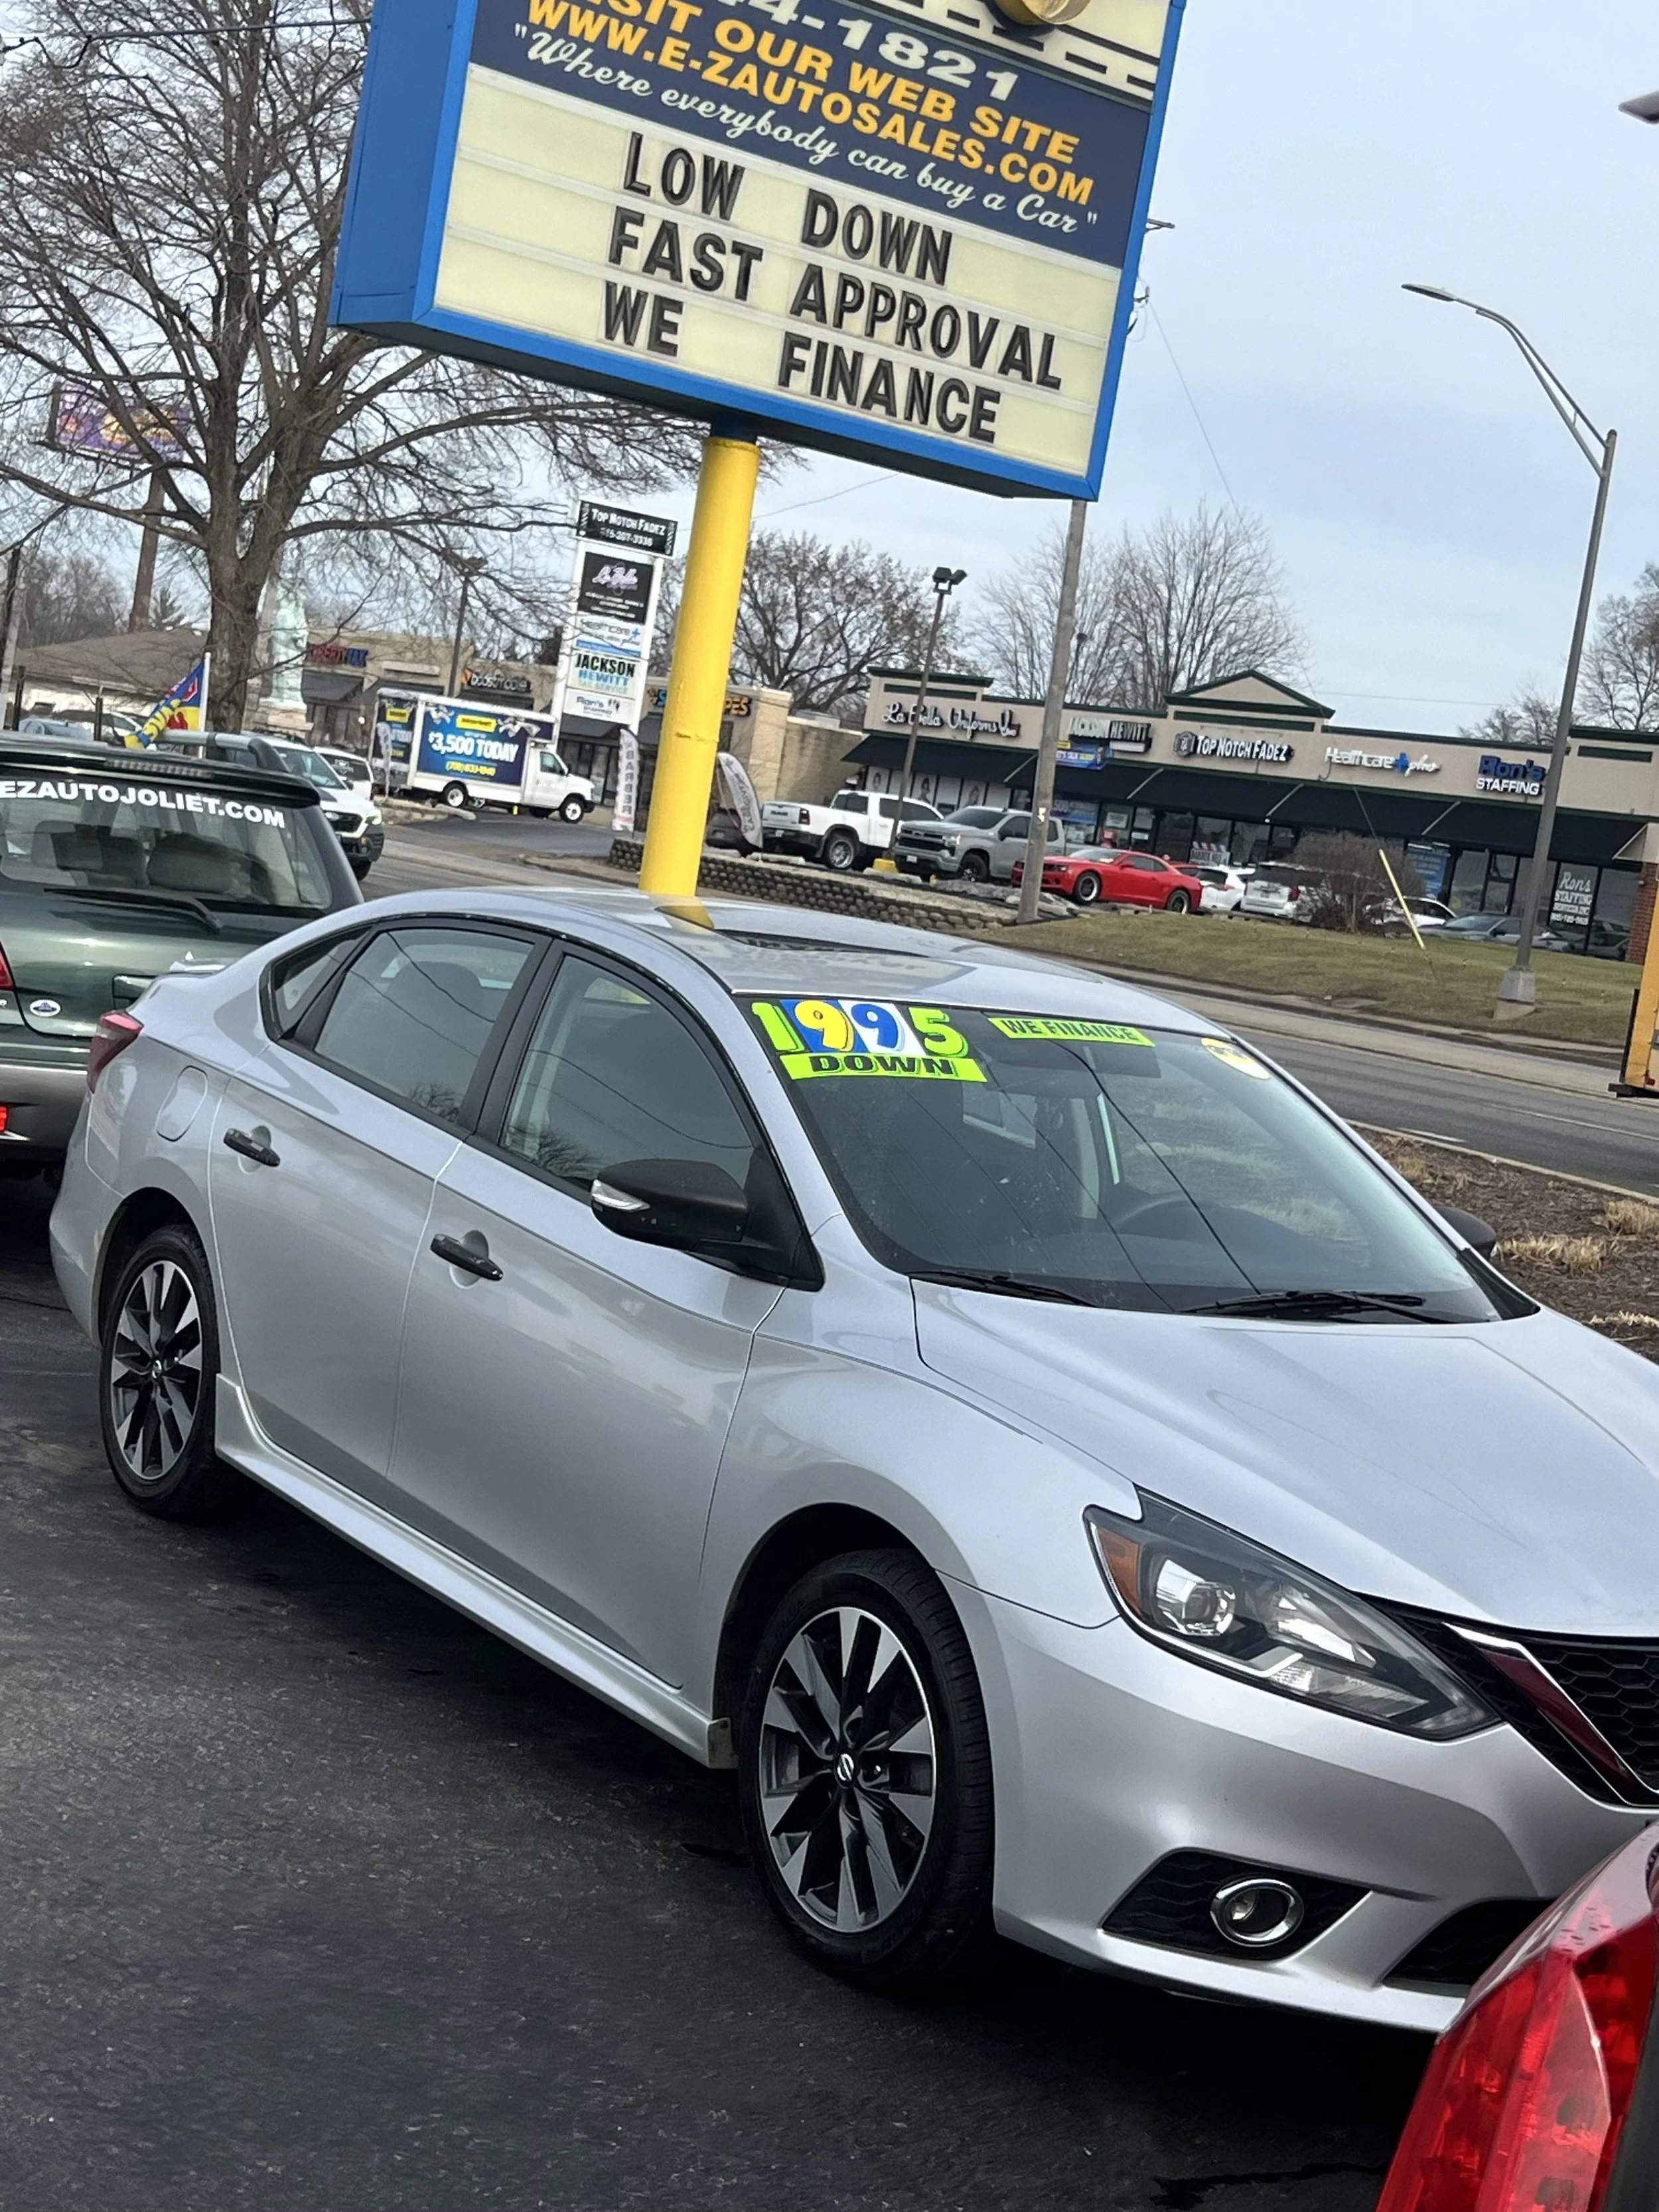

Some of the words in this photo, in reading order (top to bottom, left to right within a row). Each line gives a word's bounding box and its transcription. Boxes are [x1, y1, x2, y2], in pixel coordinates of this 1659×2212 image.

[718, 0, 1018, 101] 4-1821
[529, 0, 1094, 205] WWW.E-ZAUTOSALES.COM
[715, 19, 833, 82] OUR
[848, 62, 956, 122] WEB
[970, 106, 1080, 164] SITE
[514, 23, 653, 97] "Where
[660, 87, 839, 165] everybody
[847, 149, 908, 180] can
[916, 163, 975, 208] buy
[983, 192, 1007, 211] a
[623, 131, 745, 220] LOW
[801, 188, 953, 286] DOWN
[608, 206, 763, 301] FAST
[790, 263, 1062, 390] APPROVAL
[605, 281, 684, 357] WE
[778, 331, 1000, 443] FINANCE
[575, 653, 636, 678] JACKSON
[578, 669, 629, 687] HEWITT
[882, 703, 904, 723] La
[428, 731, 474, 755] $3,500
[476, 739, 519, 763] TODAY
[1196, 735, 1217, 755] TOP
[1216, 737, 1252, 759] NOTCH
[1252, 739, 1288, 761] FADEZ
[1475, 777, 1541, 796] STAFFING
[1479, 755, 1546, 782] Ron's
[0, 780, 285, 828] EZAUTOJOLIET.COM
[751, 999, 969, 1057] 1995
[999, 1019, 1042, 1035] WE
[1041, 1021, 1139, 1041] FINANCE
[808, 1055, 960, 1077] DOWN
